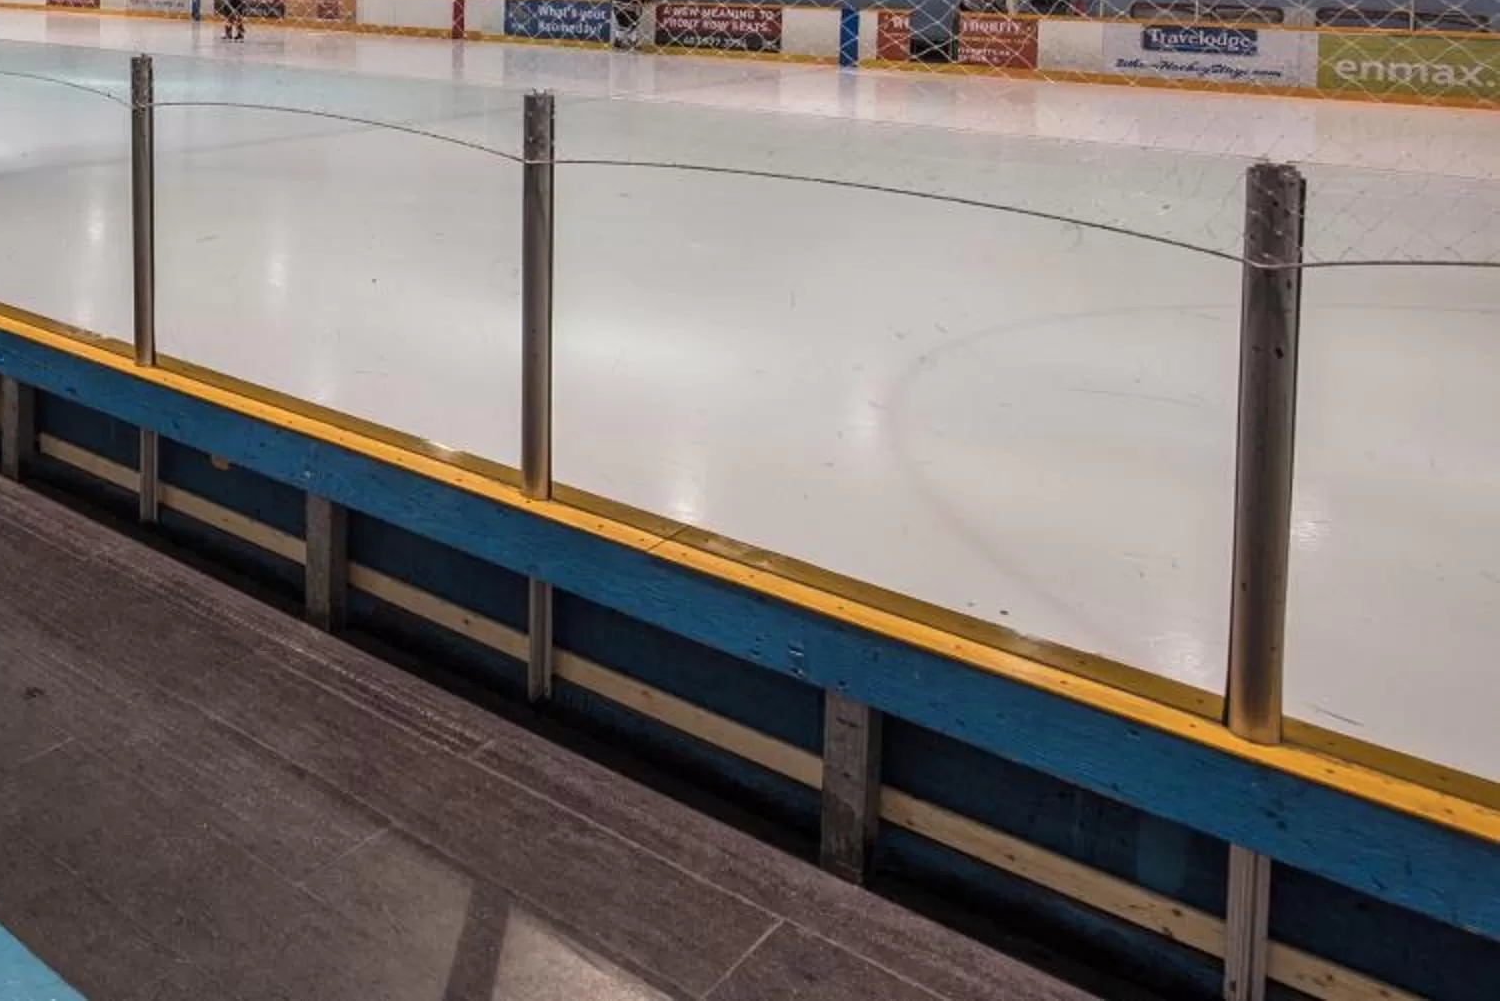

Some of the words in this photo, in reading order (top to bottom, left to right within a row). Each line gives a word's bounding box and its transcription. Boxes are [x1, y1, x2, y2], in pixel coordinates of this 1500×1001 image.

[537, 4, 577, 19] What's
[702, 8, 755, 20] MEANING
[761, 10, 775, 20] TO
[1150, 28, 1251, 50] Travelodge
